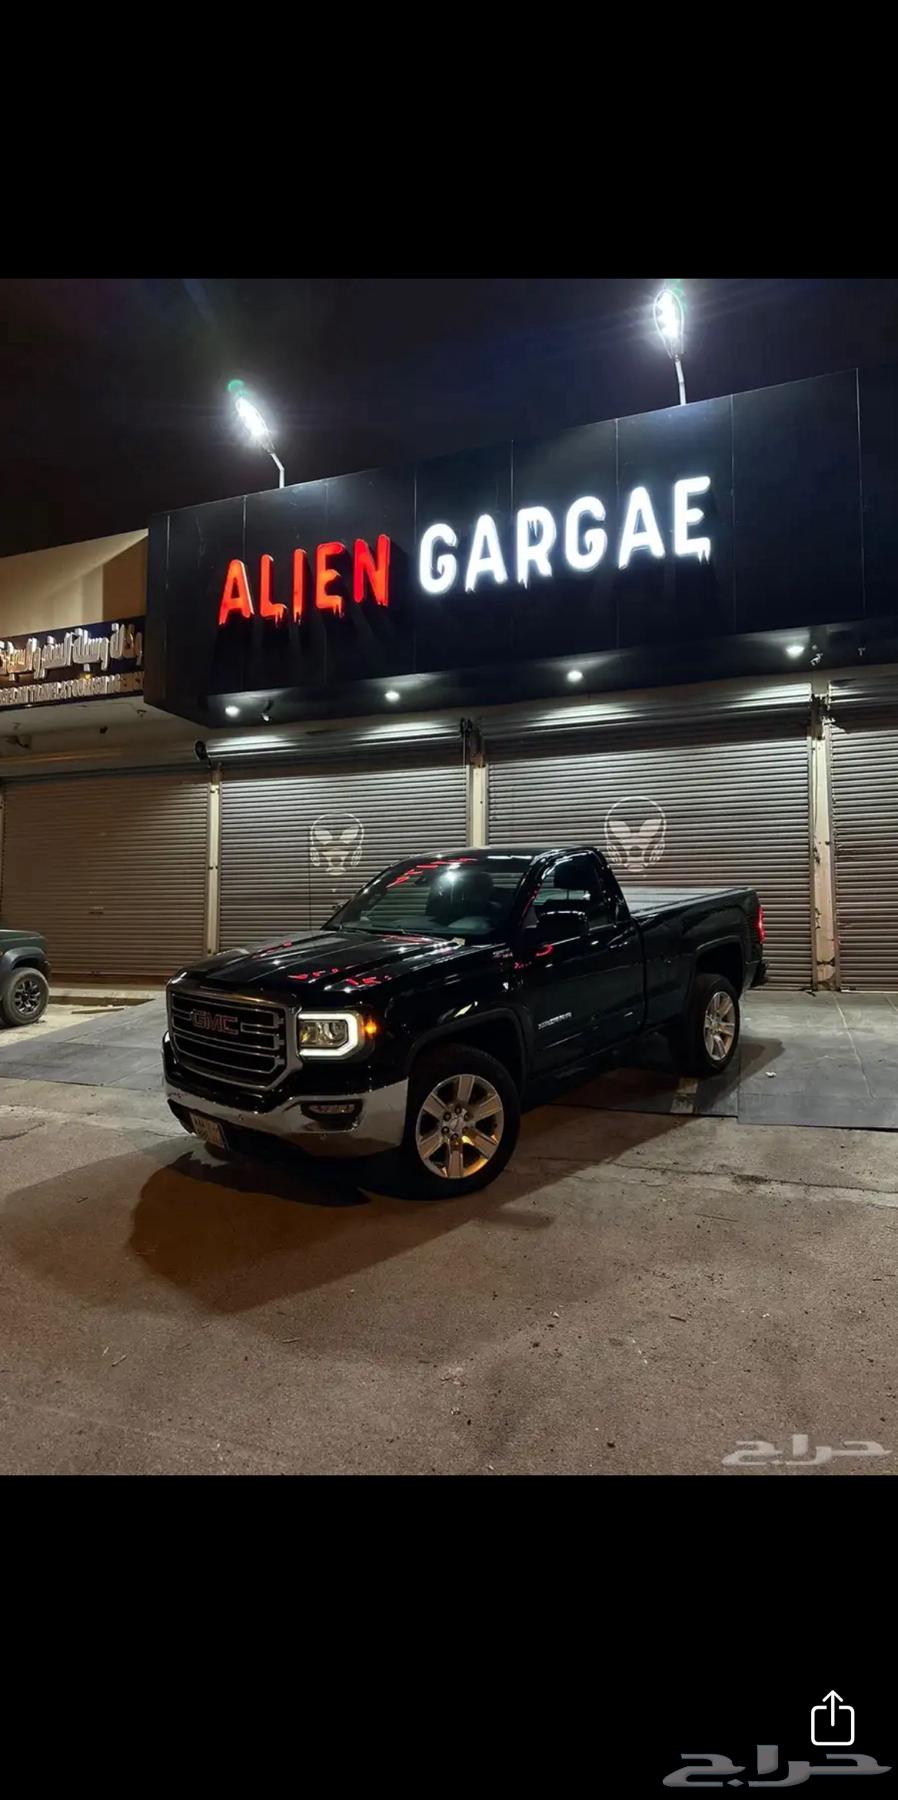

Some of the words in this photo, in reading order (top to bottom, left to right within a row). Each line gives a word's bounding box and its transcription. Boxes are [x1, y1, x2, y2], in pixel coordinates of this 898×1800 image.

[218, 534, 391, 626] ALIEN
[419, 475, 711, 594] GARGAE
[191, 1008, 240, 1036] GMC
